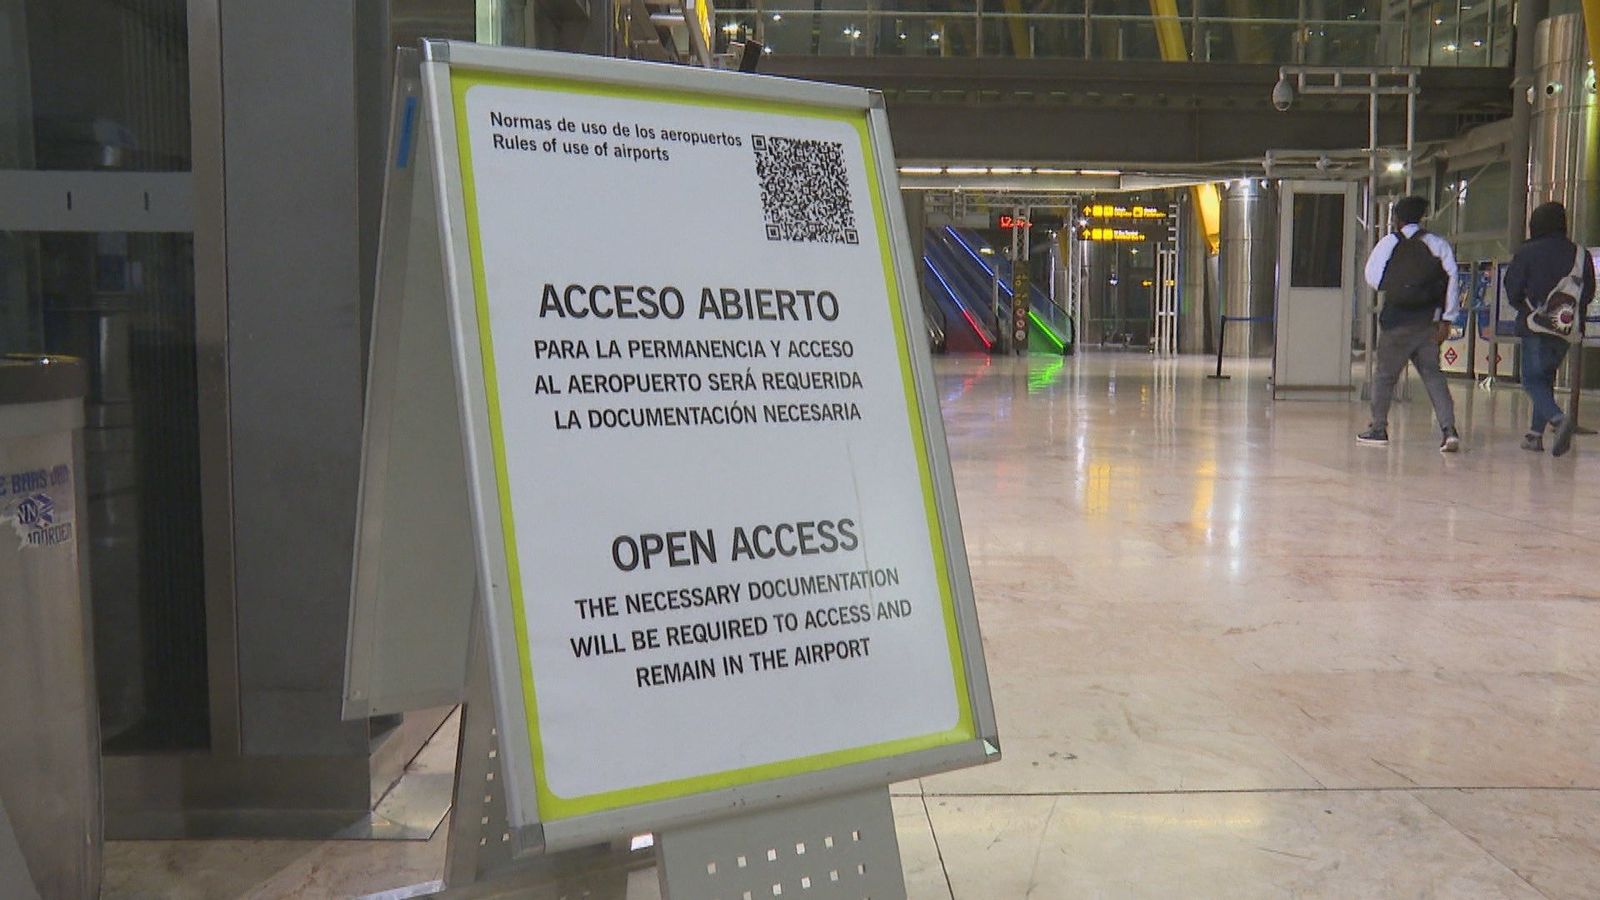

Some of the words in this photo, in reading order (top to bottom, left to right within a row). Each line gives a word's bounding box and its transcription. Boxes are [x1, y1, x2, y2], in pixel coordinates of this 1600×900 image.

[490, 112, 552, 130] Normas
[558, 118, 575, 132] de
[582, 123, 607, 135] uso
[613, 122, 630, 137] de
[635, 124, 655, 139] los
[661, 130, 742, 146] aeropuertos
[493, 134, 537, 151] Rules
[543, 138, 556, 152] of
[563, 143, 589, 154] use
[595, 142, 607, 156] of
[614, 144, 669, 162] airports
[539, 284, 684, 319] ACCESO
[699, 288, 839, 321] ABIERTO
[534, 340, 589, 359] PARA
[596, 340, 621, 358] LA
[628, 340, 766, 358] PERMANENCIA
[770, 340, 781, 357] Y
[789, 340, 853, 357] ACCESO
[535, 375, 561, 394] AL
[568, 374, 701, 394] AEROPUERTO
[708, 367, 757, 391] SERÁ
[762, 372, 863, 390] REQUERIDA
[555, 410, 581, 430] LA
[588, 401, 757, 428] DOCUMENTACIÓN
[763, 403, 861, 422] NECESARIA
[612, 529, 717, 571] OPEN
[732, 519, 858, 561] ACCESS
[574, 596, 619, 619] THE
[626, 584, 740, 614] NECESSARY
[748, 568, 899, 600] DOCUMENTATION
[570, 633, 626, 658] WILL
[632, 629, 660, 650] BE
[666, 617, 767, 646] REQUIRED
[773, 613, 798, 632] TO
[805, 604, 870, 629] ACCESS
[878, 600, 911, 620] AND
[636, 658, 715, 687] REMAIN
[723, 655, 743, 676] IN
[749, 649, 788, 671] THE
[795, 638, 869, 666] AIRPORT
